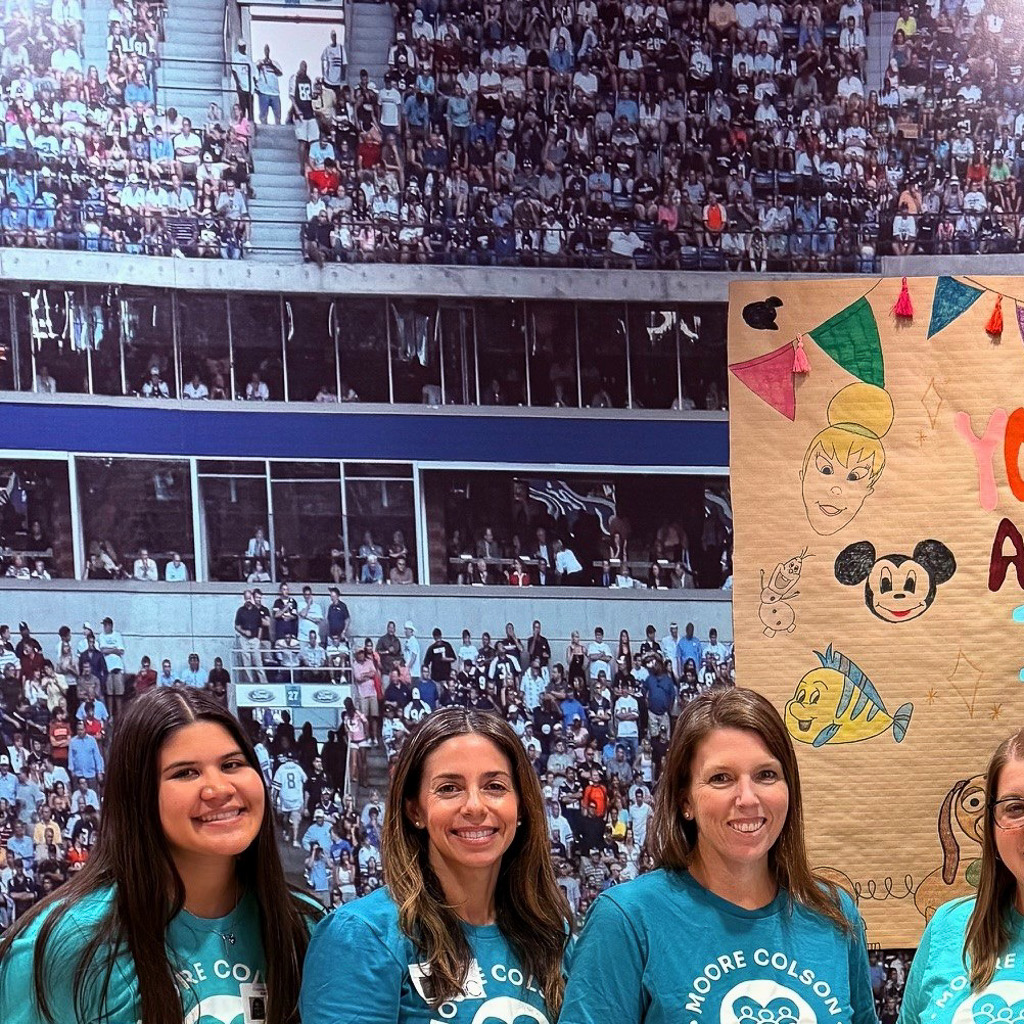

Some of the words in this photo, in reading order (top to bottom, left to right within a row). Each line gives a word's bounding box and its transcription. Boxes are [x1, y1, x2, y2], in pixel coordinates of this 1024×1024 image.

[478, 676, 486, 690] 9
[287, 690, 299, 700] 27
[286, 772, 296, 789] 8
[685, 950, 747, 1015] MOORE
[753, 948, 842, 1016] COLSON
